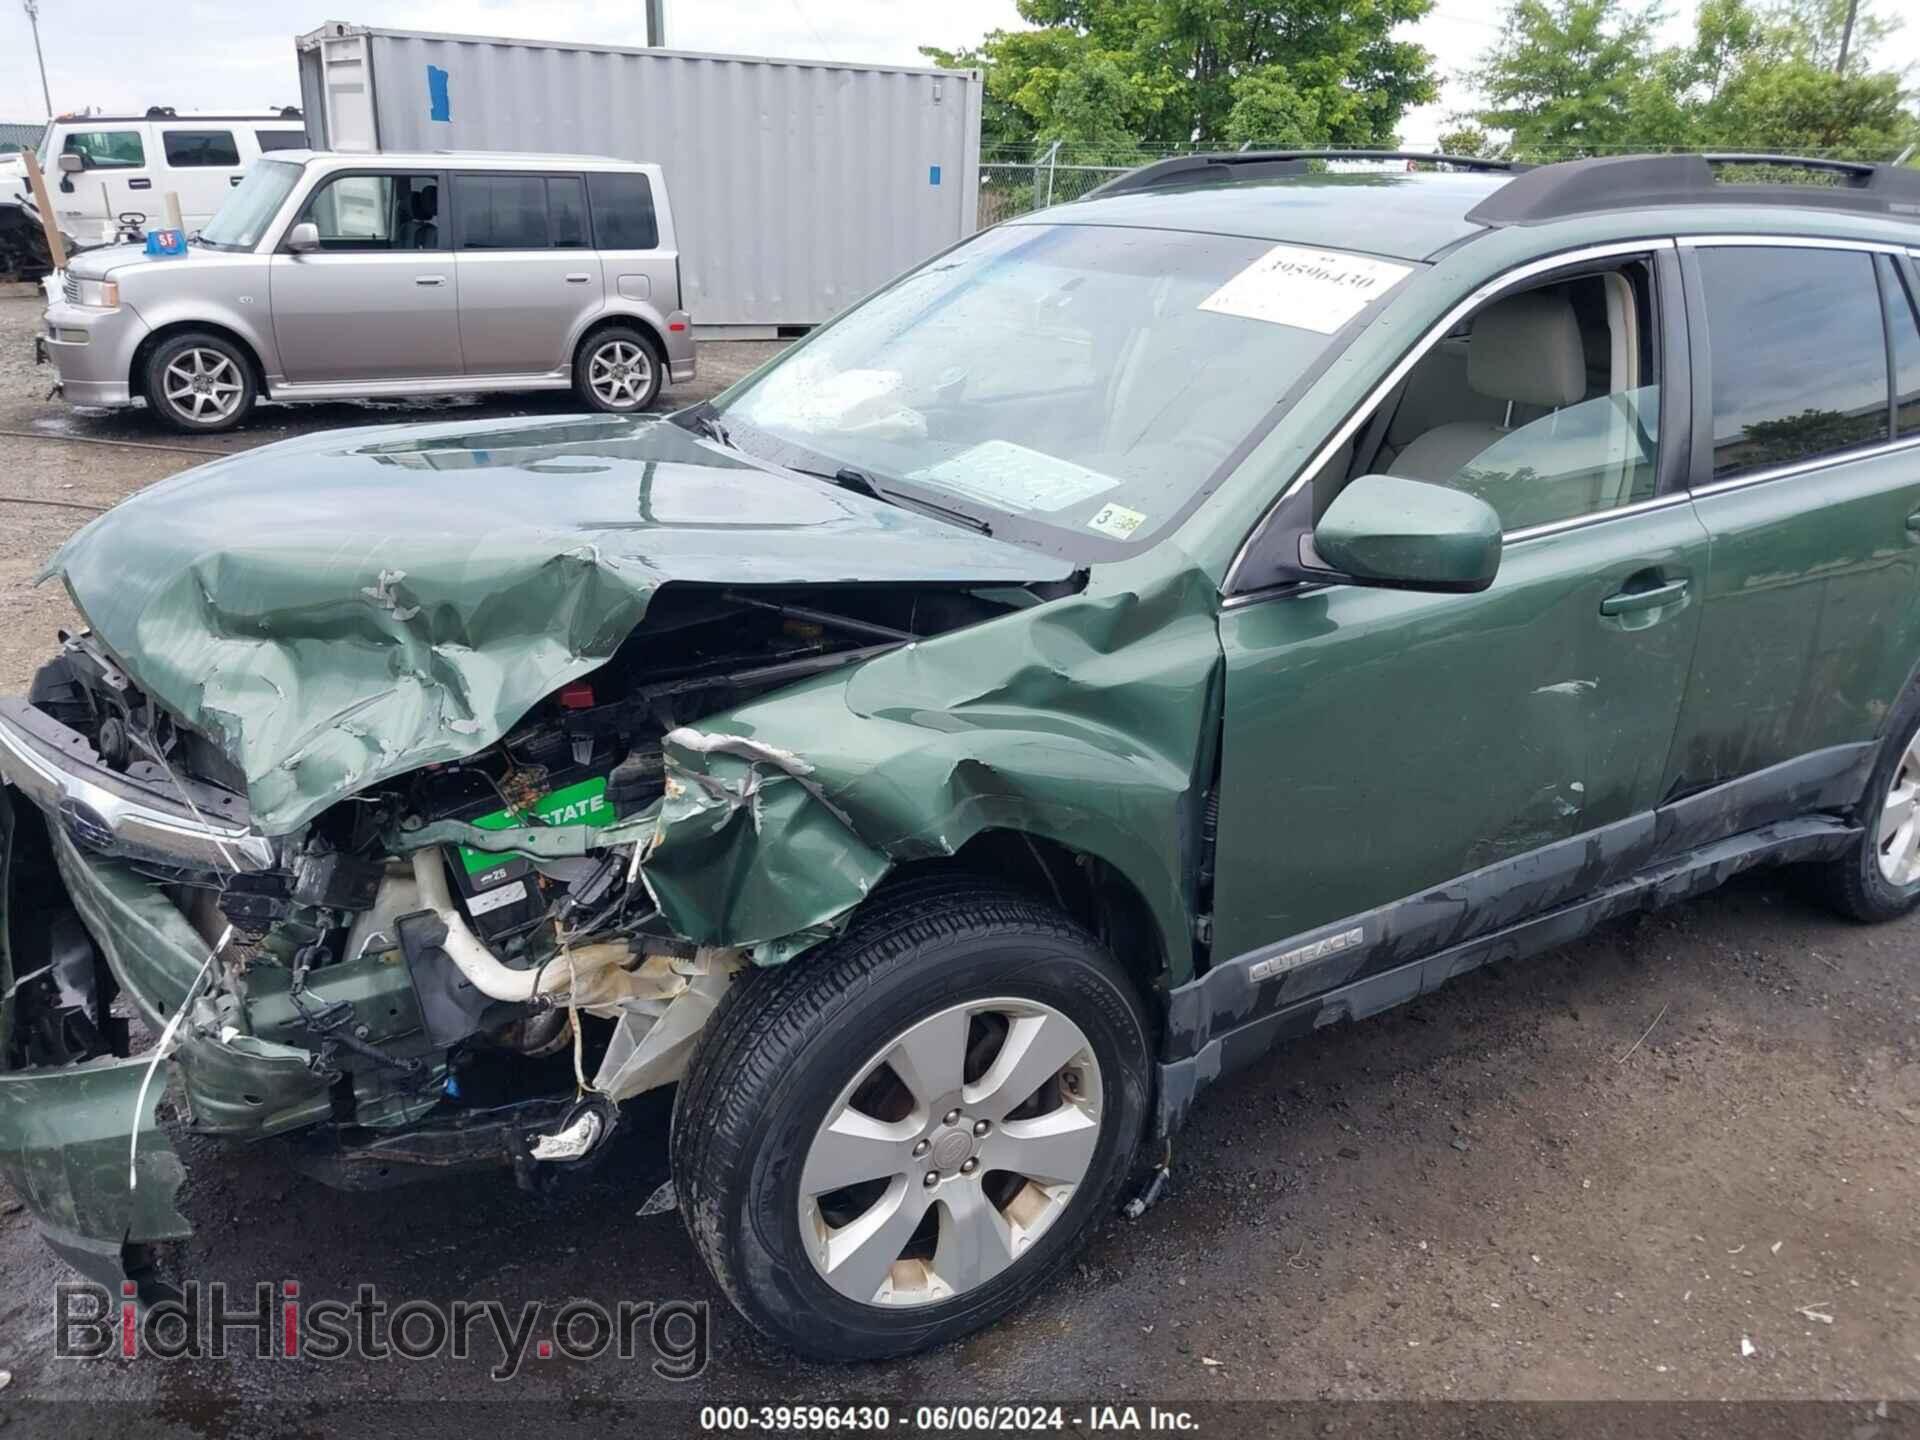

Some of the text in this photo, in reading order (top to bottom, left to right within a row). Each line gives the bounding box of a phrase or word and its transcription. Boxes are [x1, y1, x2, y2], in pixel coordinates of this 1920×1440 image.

[1271, 260, 1376, 288] 39596430
[1096, 510, 1113, 525] 3
[541, 794, 605, 826] STATE
[1249, 928, 1363, 981] OUTBACK
